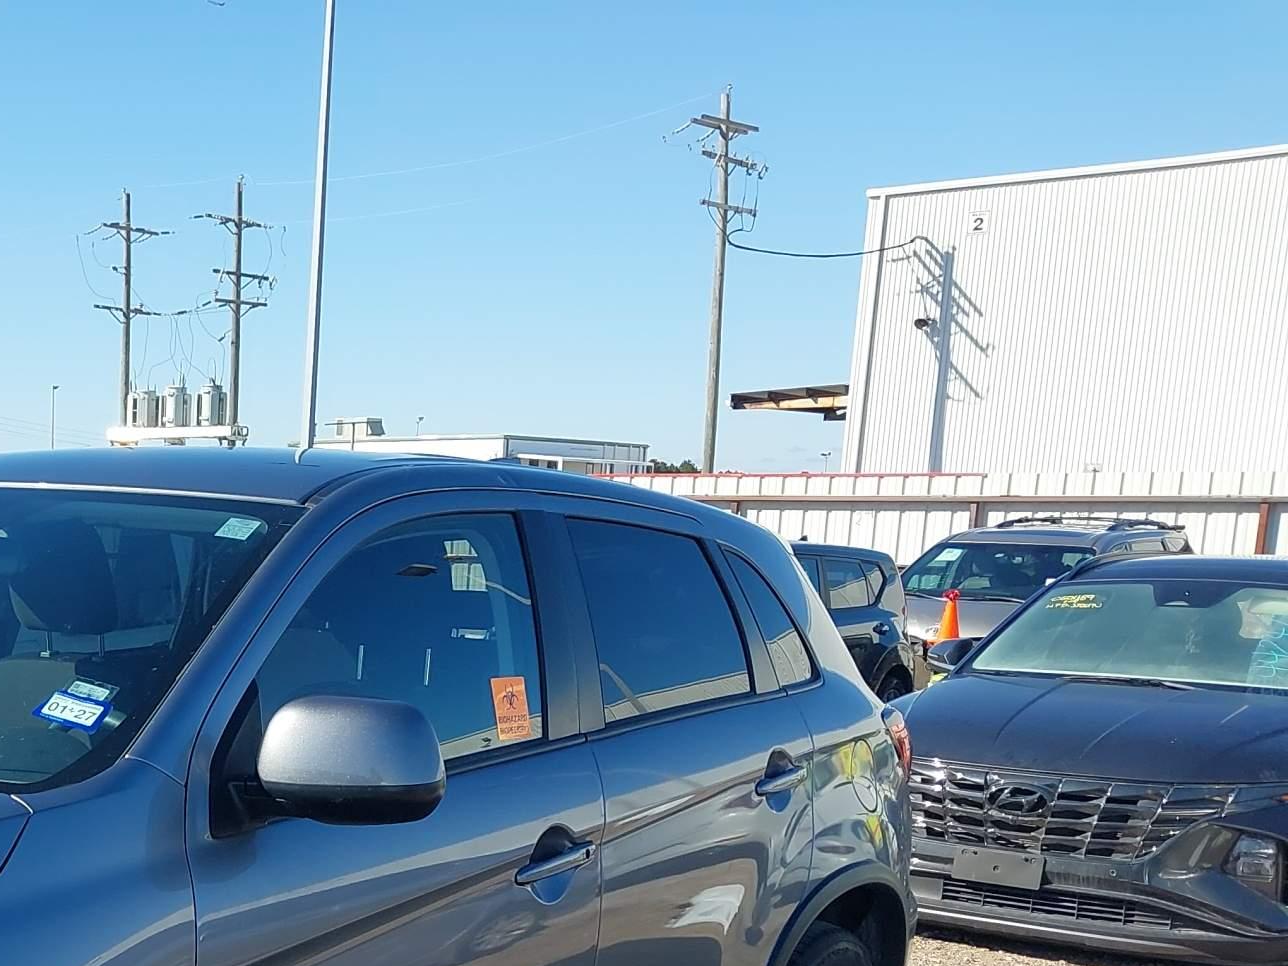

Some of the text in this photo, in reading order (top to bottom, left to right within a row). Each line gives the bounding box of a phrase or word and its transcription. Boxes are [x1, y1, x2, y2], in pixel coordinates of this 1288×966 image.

[972, 217, 984, 231] 2
[47, 701, 68, 714] 01
[74, 709, 97, 721] 27
[498, 713, 529, 724] BIOHAZARD
